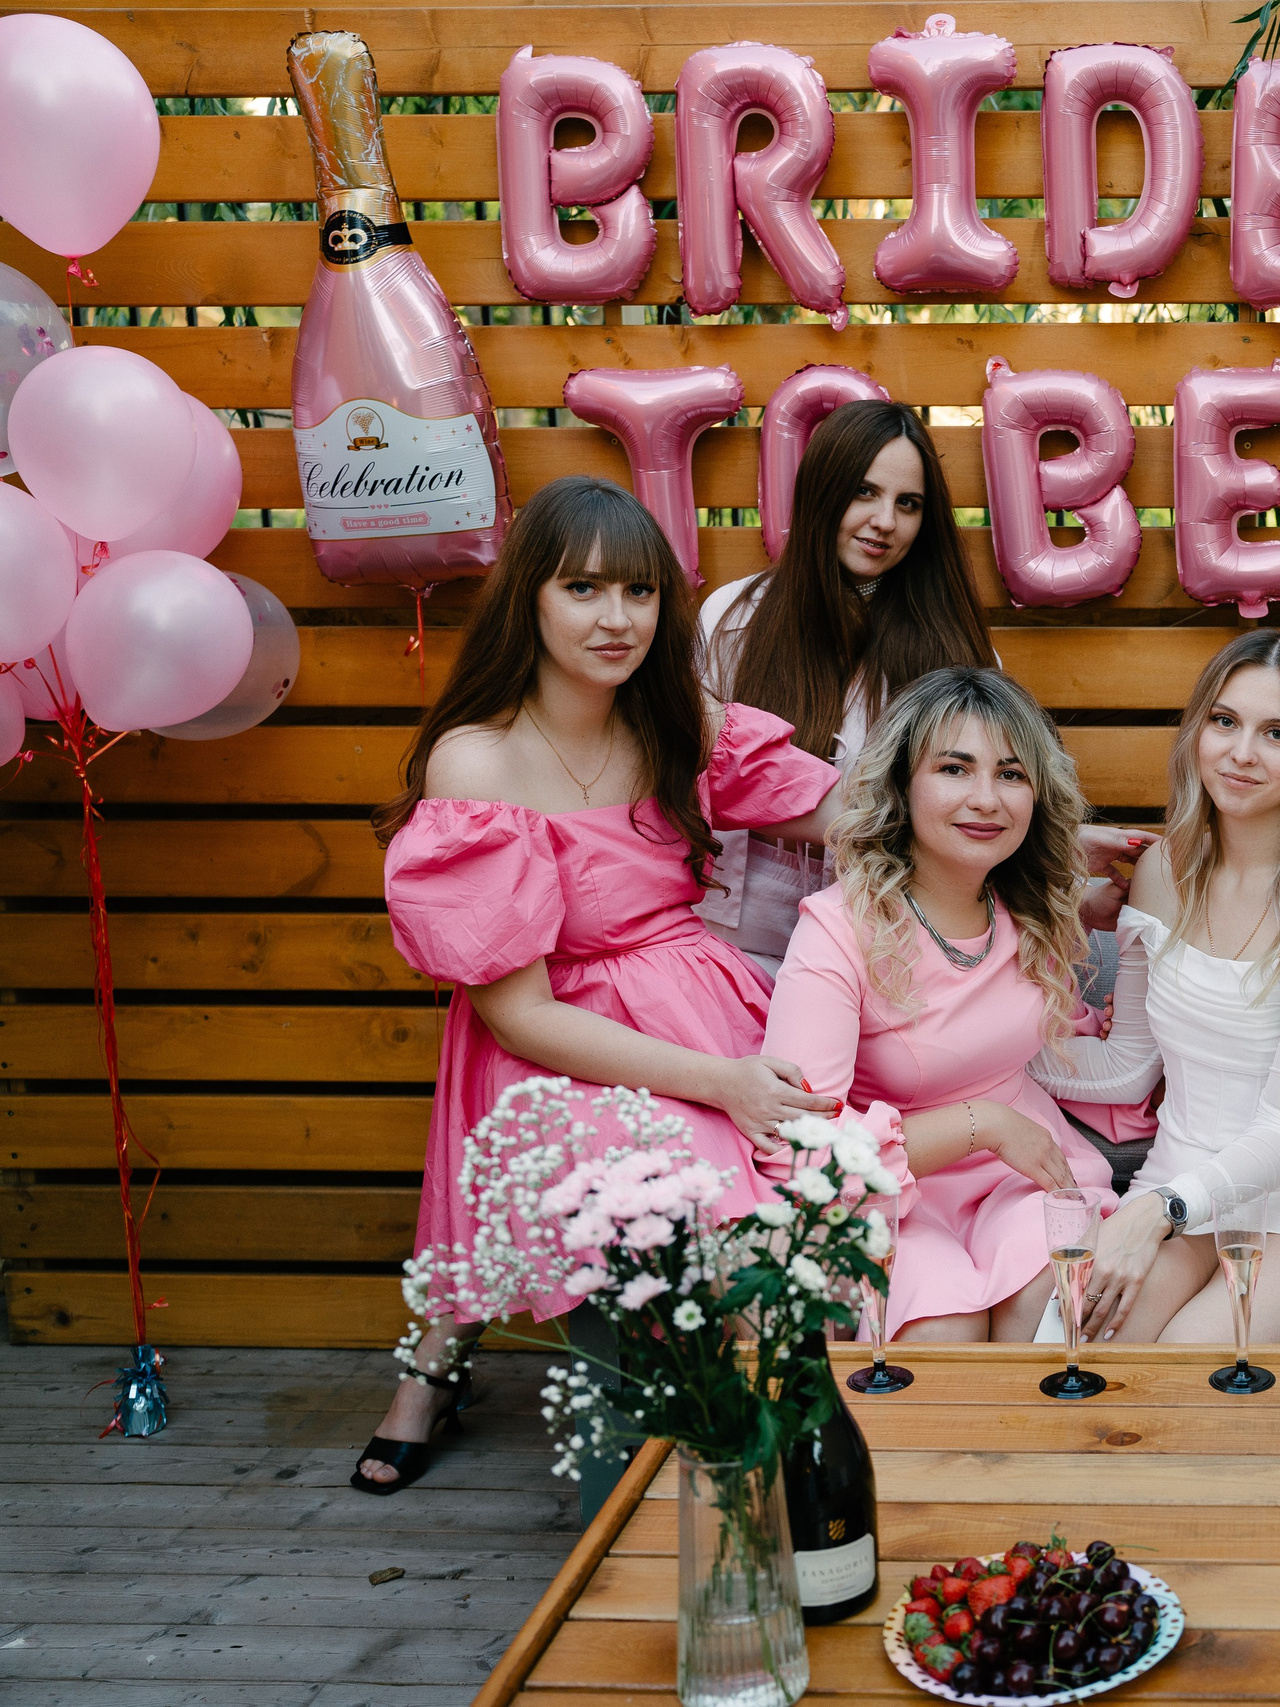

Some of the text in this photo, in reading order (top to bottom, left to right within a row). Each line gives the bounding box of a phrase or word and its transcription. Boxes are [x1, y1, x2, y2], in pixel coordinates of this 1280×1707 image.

[302, 461, 466, 498] Celebration
[346, 519, 368, 528] Have
[377, 518, 400, 528] good
[402, 515, 424, 524] time
[802, 1555, 868, 1577] FANAGORIA
